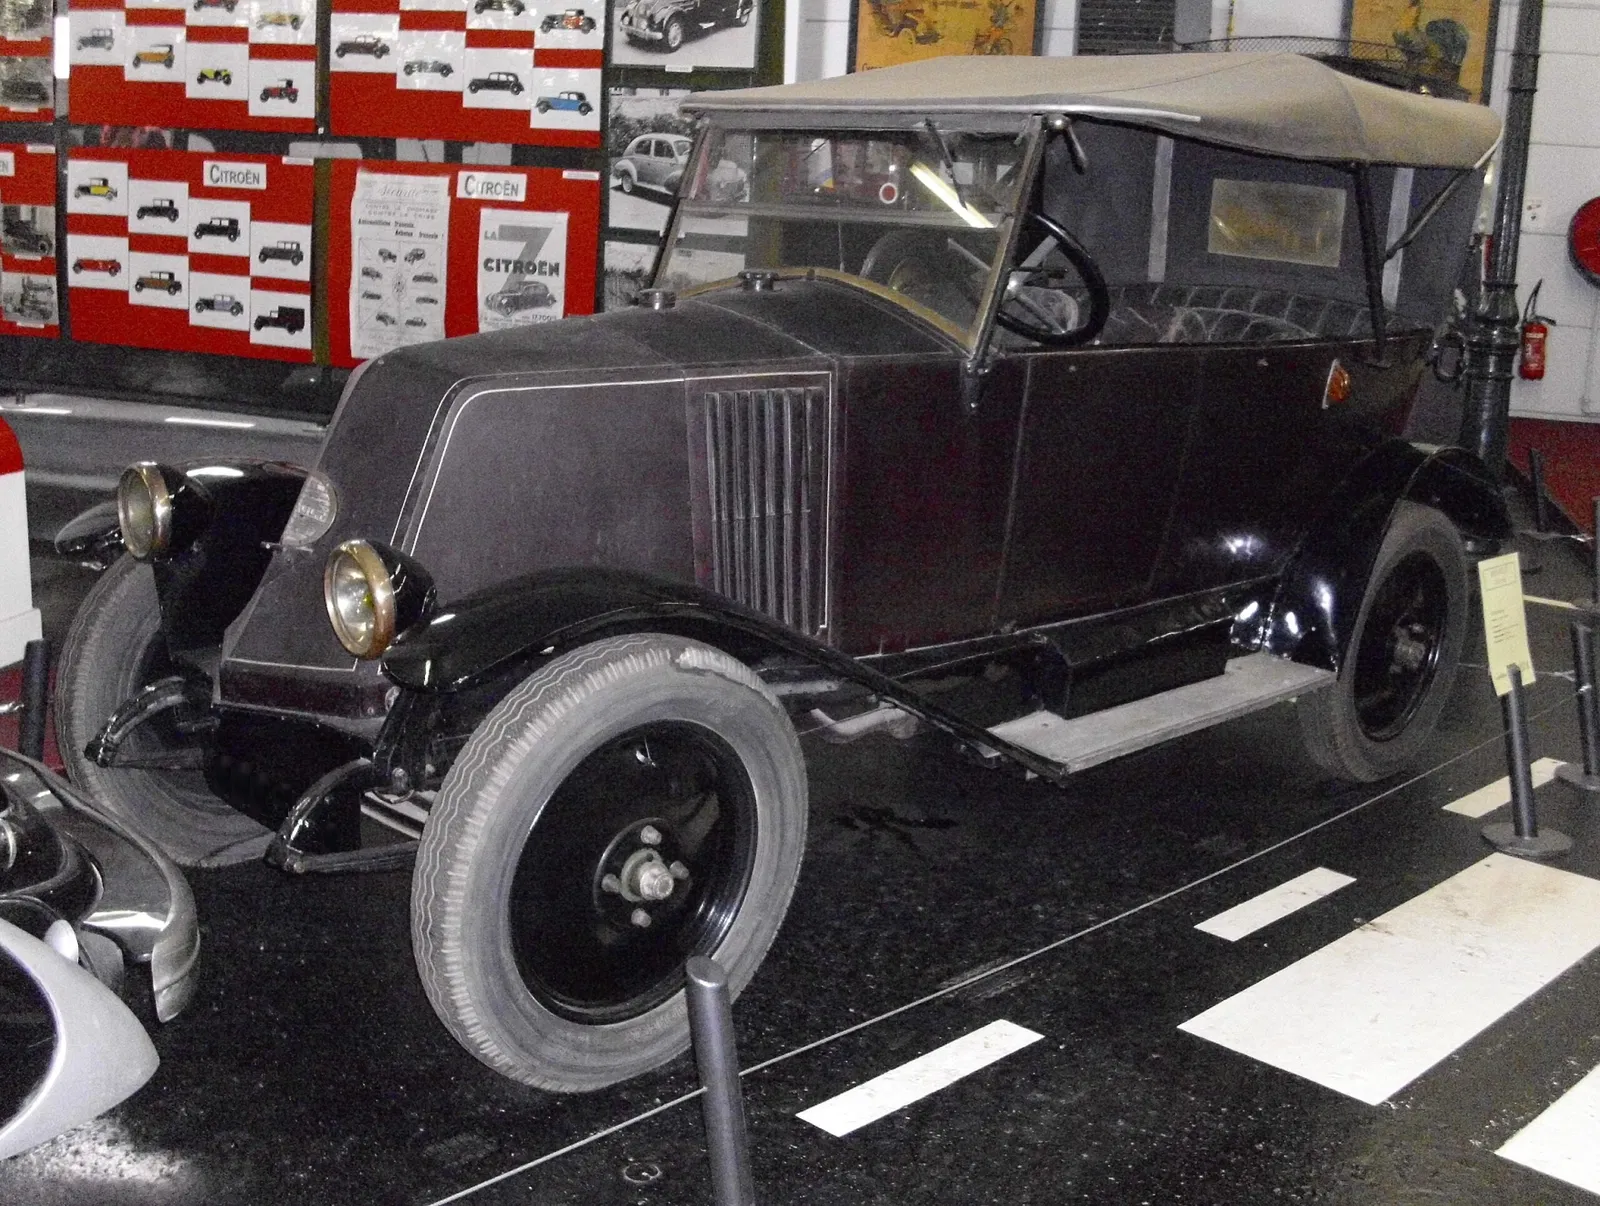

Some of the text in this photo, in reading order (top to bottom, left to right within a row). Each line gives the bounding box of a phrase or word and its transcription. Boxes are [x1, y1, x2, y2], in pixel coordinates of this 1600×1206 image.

[210, 164, 260, 185] CITROËN
[464, 174, 519, 197] CITROËN
[483, 257, 560, 277] CITROËN
[484, 225, 554, 294] LA 7
